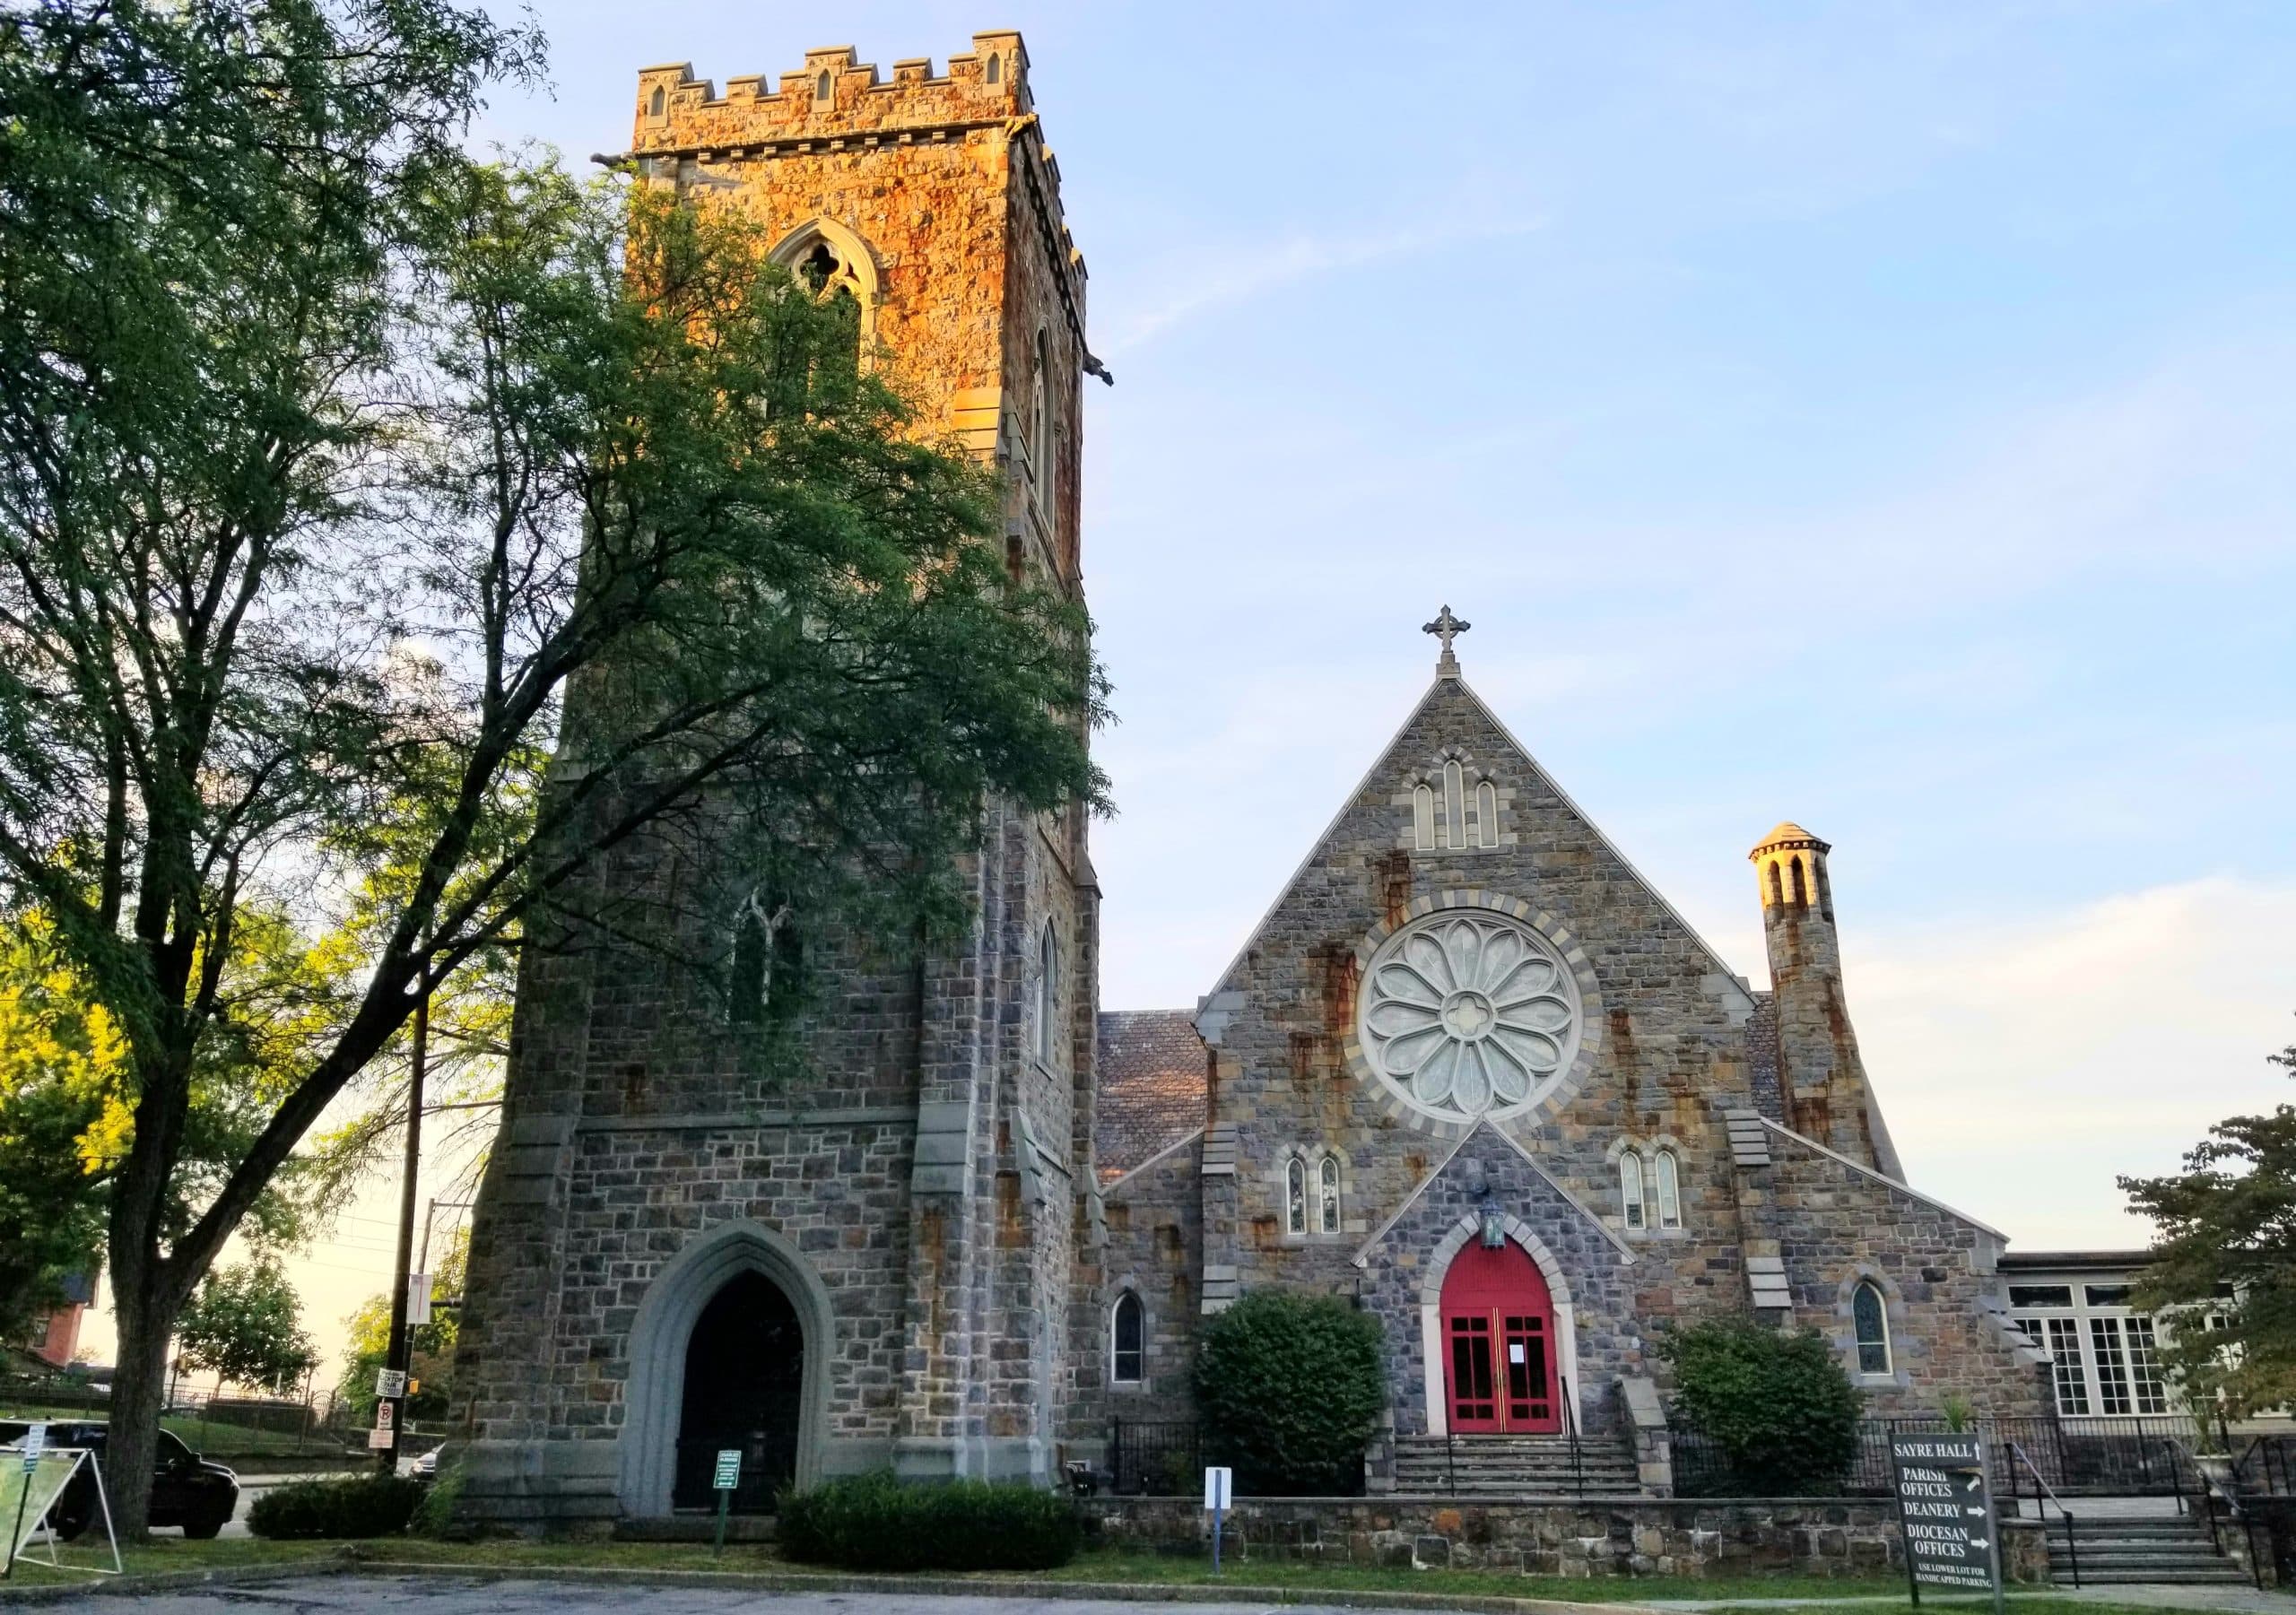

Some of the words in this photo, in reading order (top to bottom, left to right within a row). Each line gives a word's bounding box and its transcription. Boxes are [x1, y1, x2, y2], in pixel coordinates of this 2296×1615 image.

[1894, 1443, 1934, 1457] SAYRE
[1935, 1444, 1972, 1457] HALL
[1902, 1467, 1947, 1481] PARISH
[1900, 1482, 1952, 1498] OFFICES
[1903, 1501, 1961, 1518] DEANERY
[1907, 1524, 1969, 1541] DIOCESAN
[1914, 1541, 1965, 1558] OFFICES
[1918, 1563, 1931, 1572] USE
[1932, 1564, 1956, 1574] LOWER
[1956, 1565, 1971, 1576] LOT
[1971, 1567, 1986, 1576] FOR
[1916, 1573, 1961, 1585] HANDICAPPED
[1961, 1577, 1993, 1588] PARKING
